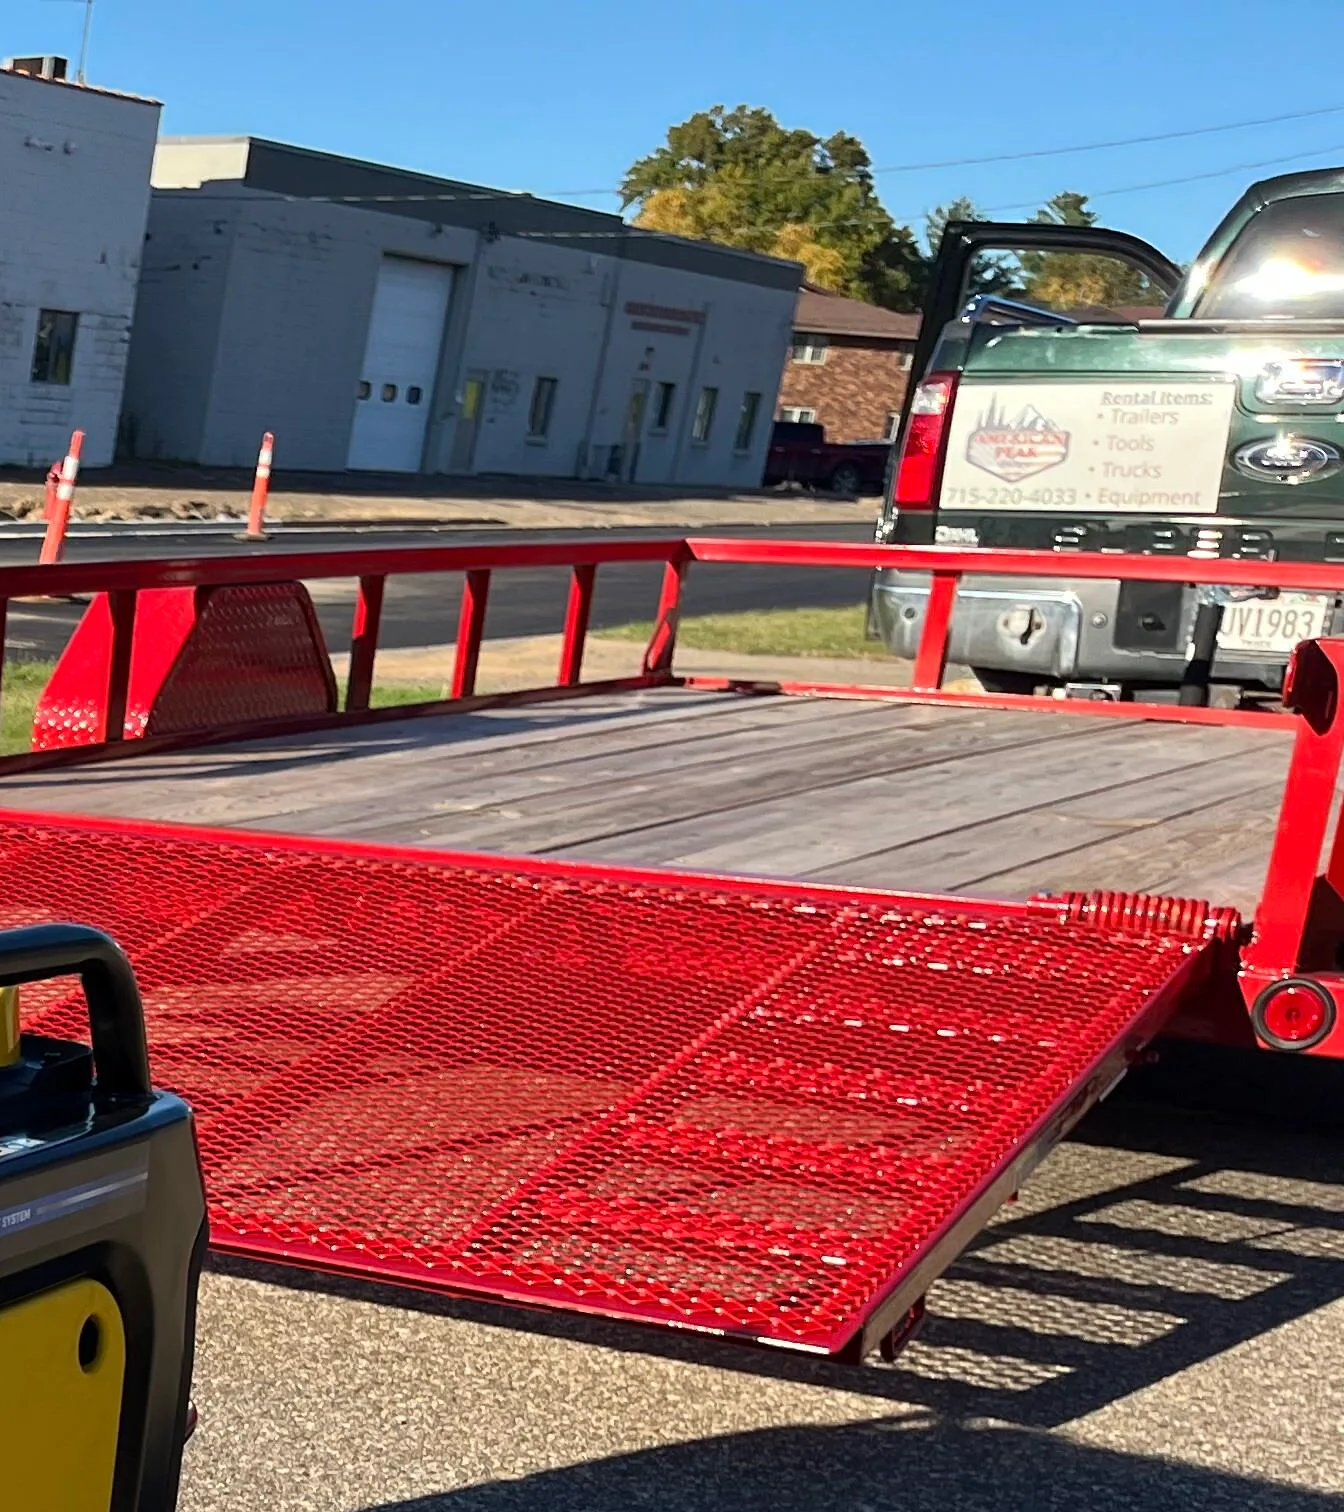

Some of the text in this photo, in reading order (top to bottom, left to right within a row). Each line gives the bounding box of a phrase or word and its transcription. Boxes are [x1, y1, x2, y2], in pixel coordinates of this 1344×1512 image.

[1100, 391, 1213, 406] Rental Items:
[1111, 407, 1180, 425] Trailers
[1107, 435, 1155, 452] Tools
[1102, 461, 1162, 479] Trucks
[946, 487, 1077, 505] 715-220-4033
[1098, 488, 1201, 508] Equipment
[2, 1208, 31, 1228] SYSTEM
